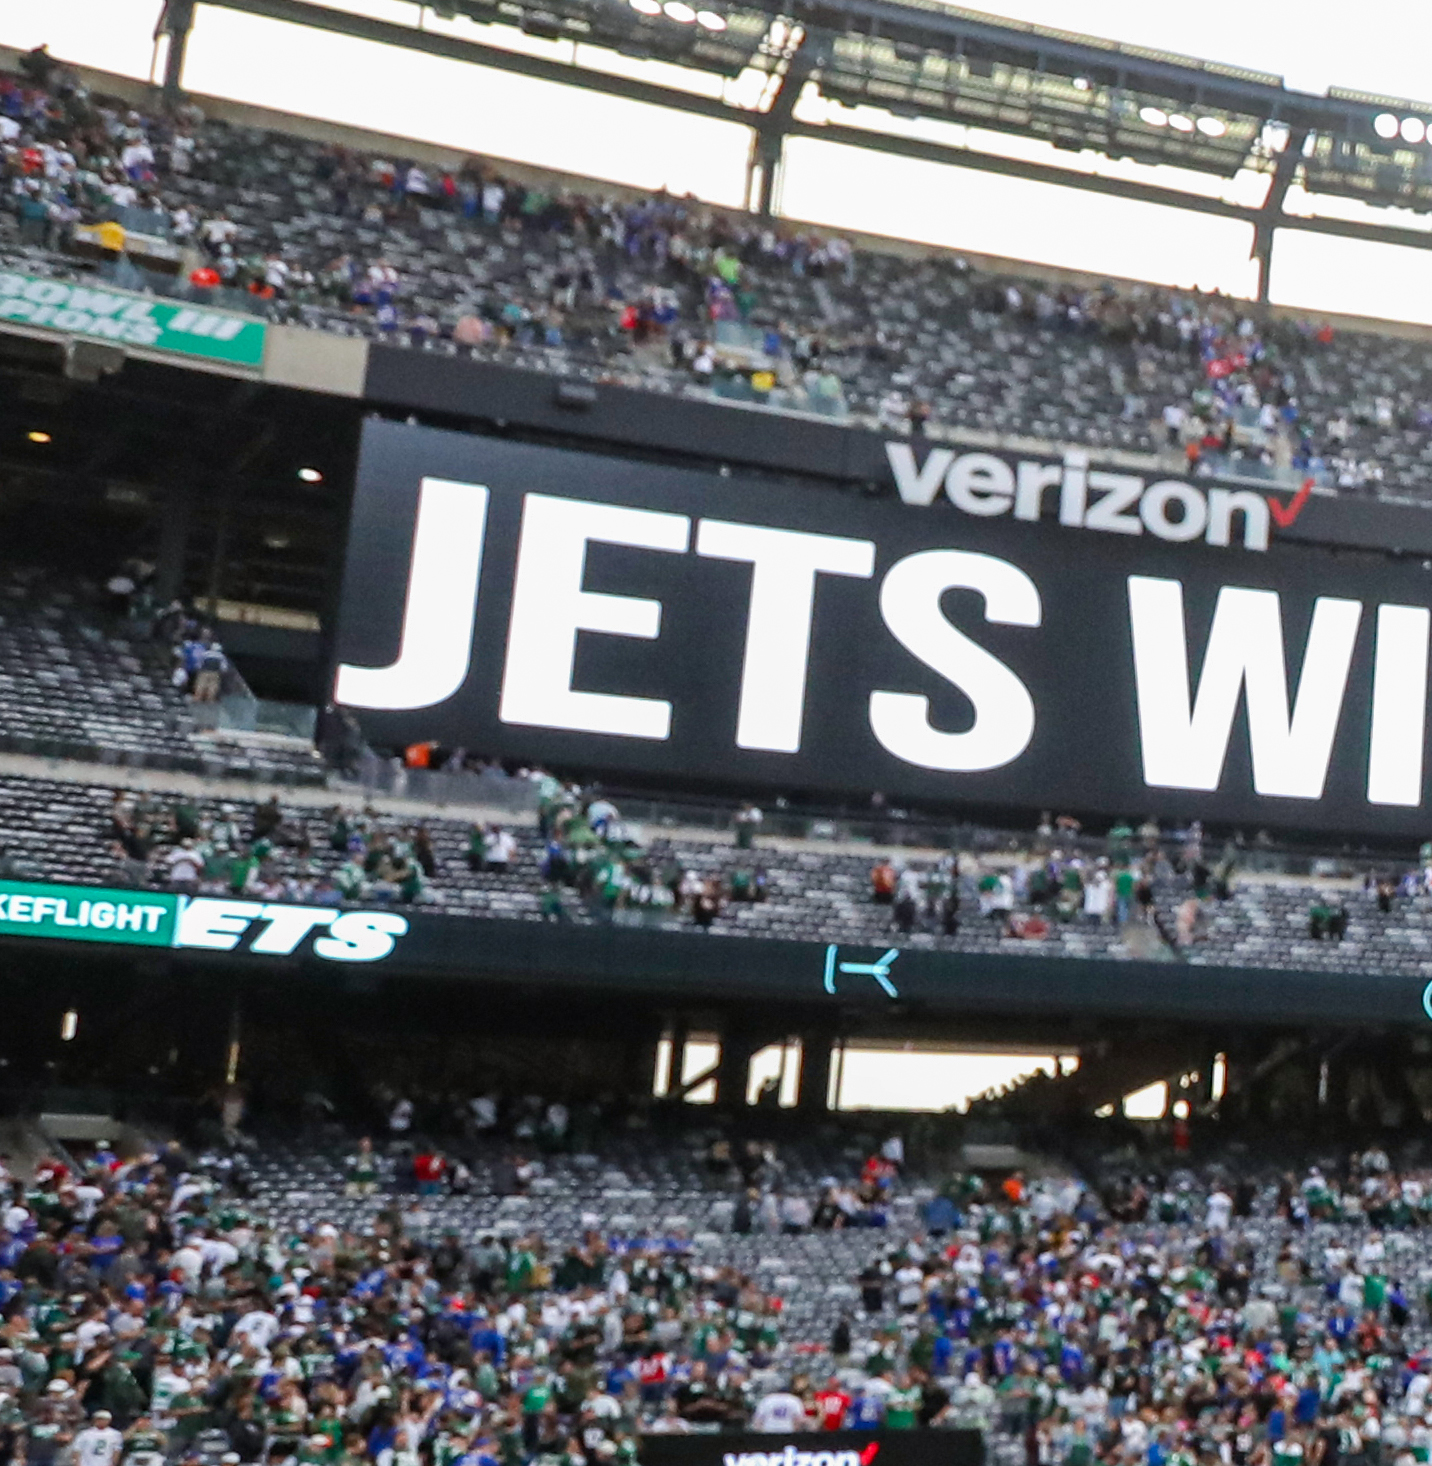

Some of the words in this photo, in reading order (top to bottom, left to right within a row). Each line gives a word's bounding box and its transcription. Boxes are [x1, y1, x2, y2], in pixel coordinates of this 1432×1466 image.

[884, 441, 1269, 552] verizon
[335, 476, 1043, 773] JETS
[181, 897, 409, 962] ETS
